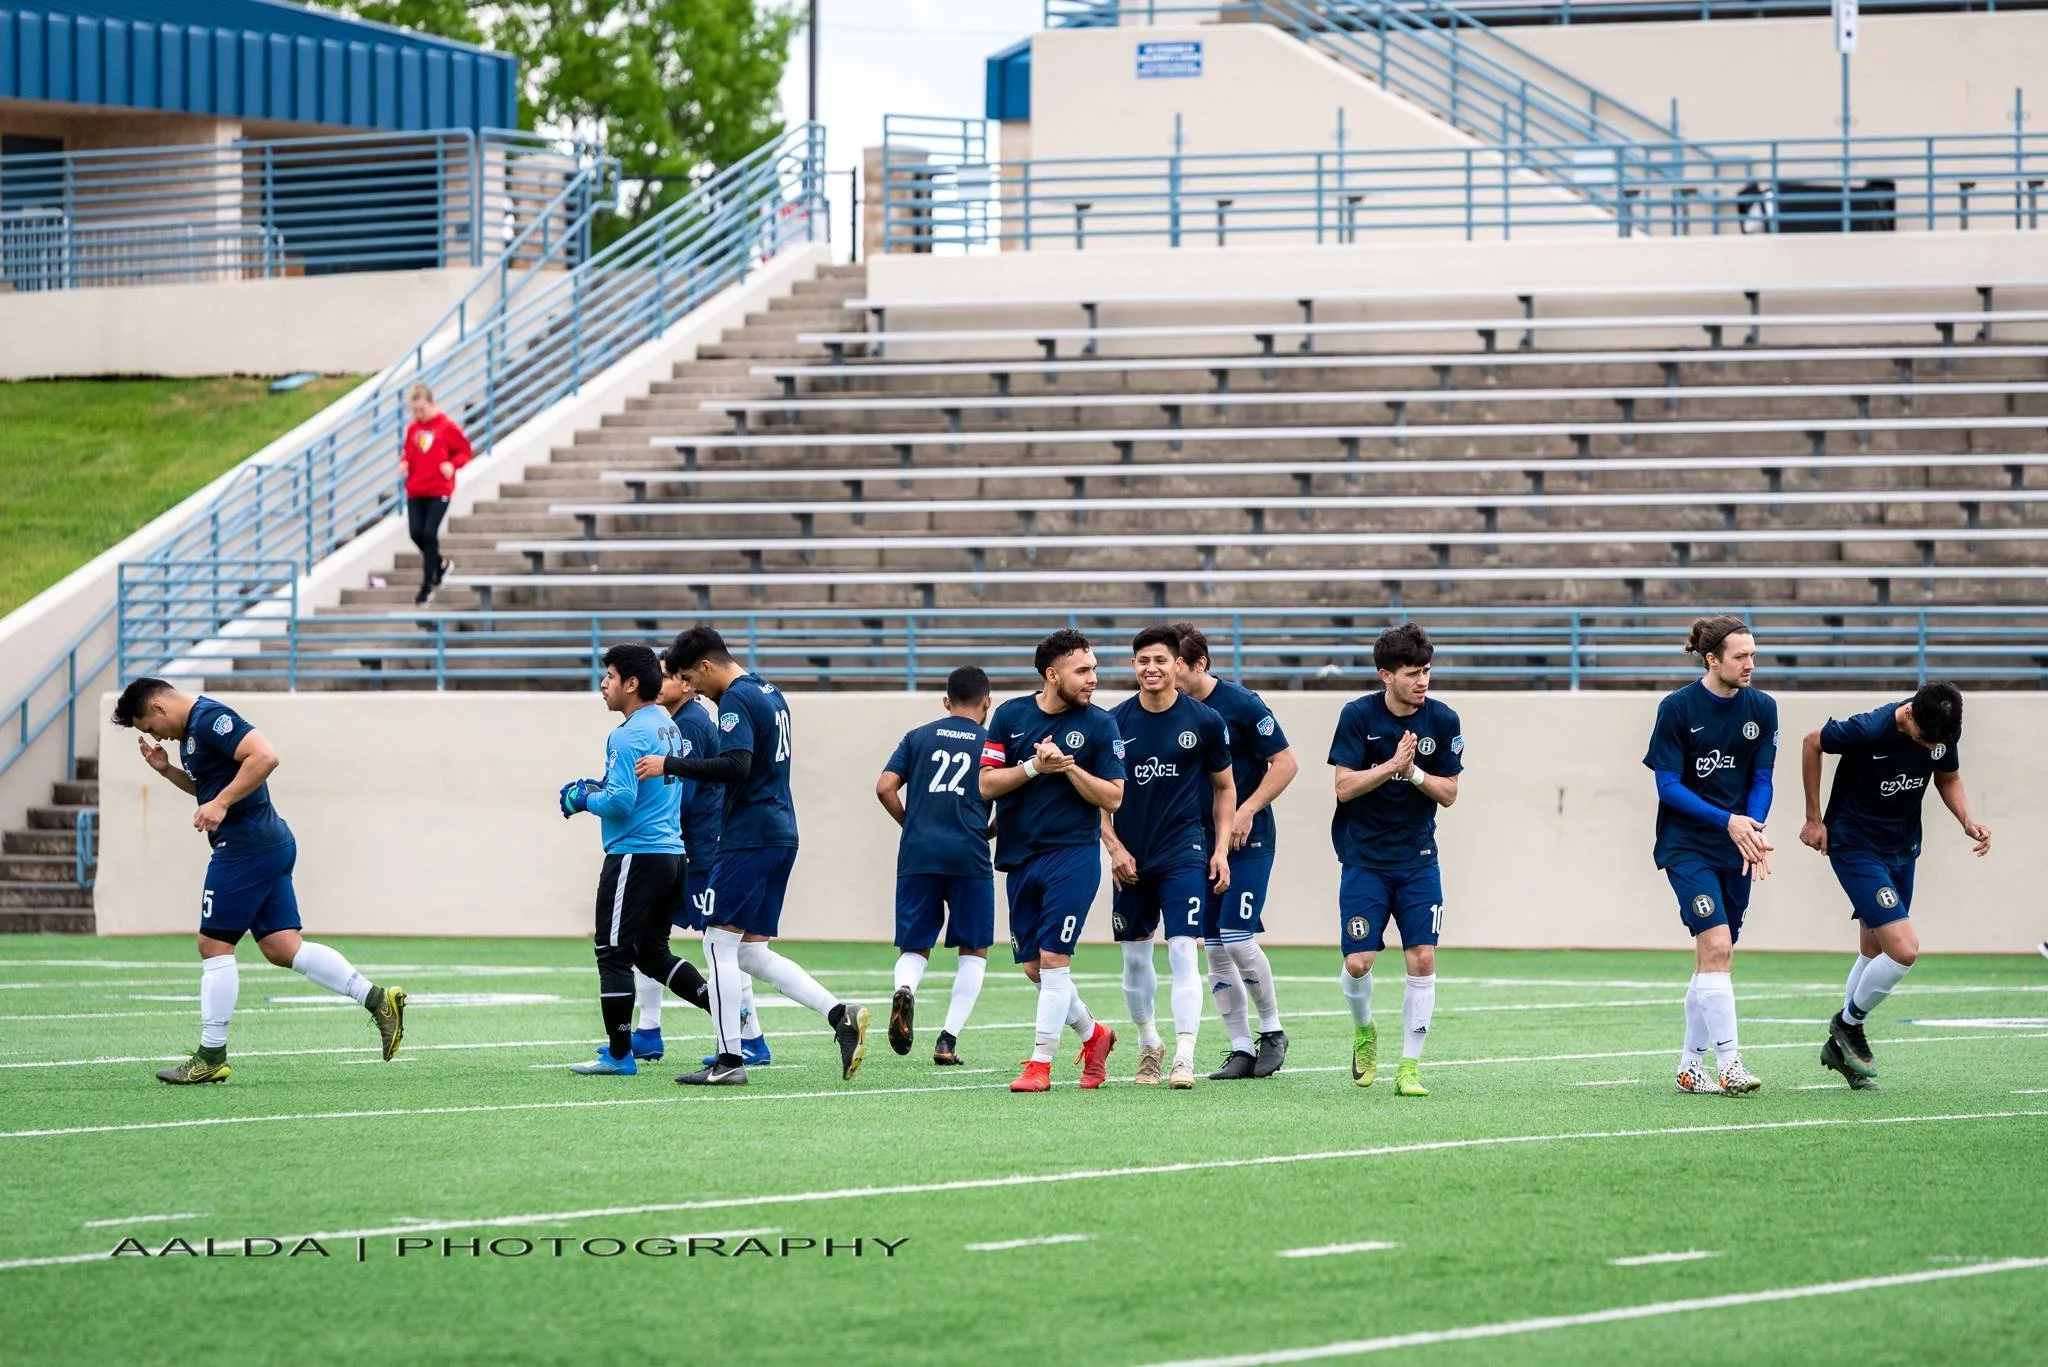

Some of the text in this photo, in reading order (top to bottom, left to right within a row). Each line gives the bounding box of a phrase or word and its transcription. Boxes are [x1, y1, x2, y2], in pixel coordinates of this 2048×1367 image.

[775, 709, 791, 762] 20
[928, 749, 971, 796] 22
[203, 889, 215, 918] 5
[1187, 896, 1201, 926] 2
[1239, 891, 1255, 920] 6
[1060, 915, 1077, 944] 8
[1430, 904, 1443, 935] 10
